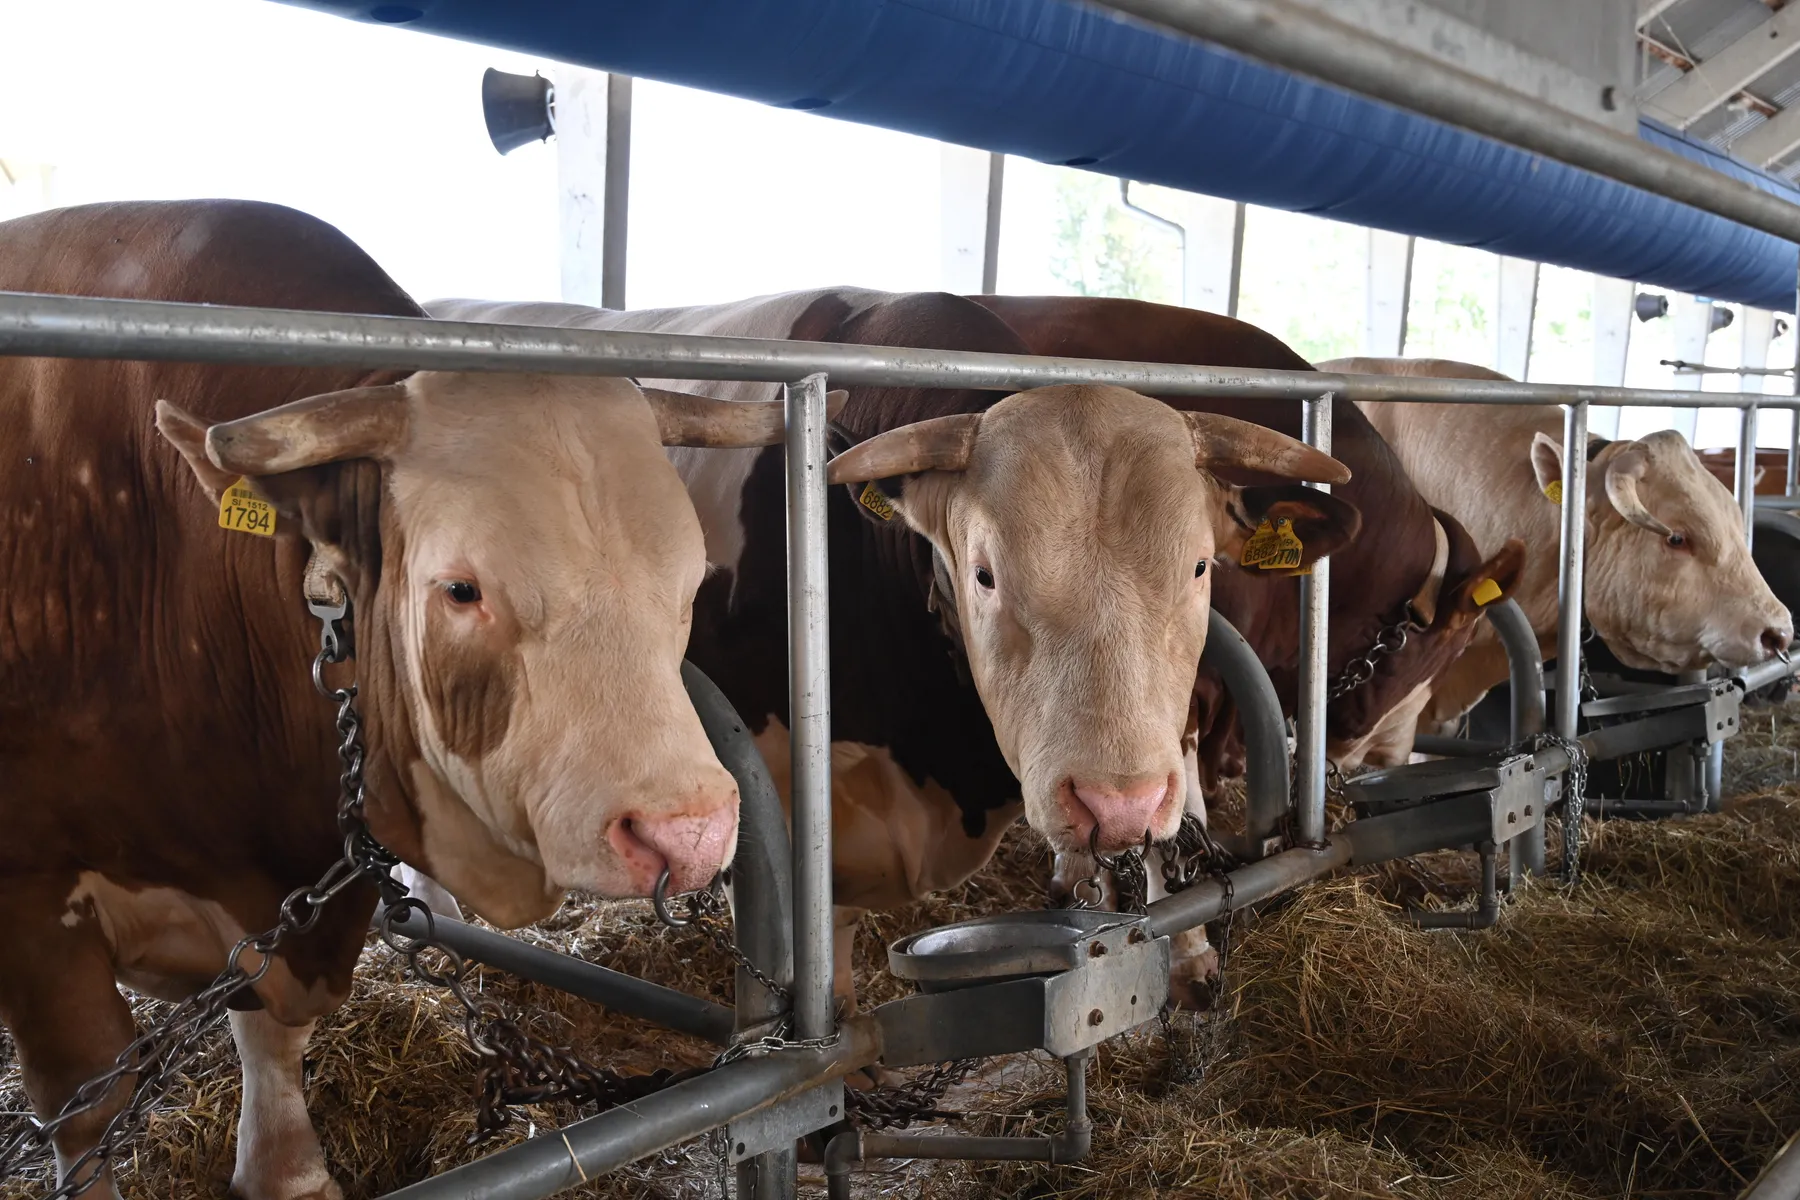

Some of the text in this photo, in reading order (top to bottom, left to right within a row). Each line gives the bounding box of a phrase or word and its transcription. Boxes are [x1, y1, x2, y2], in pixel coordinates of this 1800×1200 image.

[231, 498, 268, 512] SI 1512
[224, 506, 270, 532] 1794
